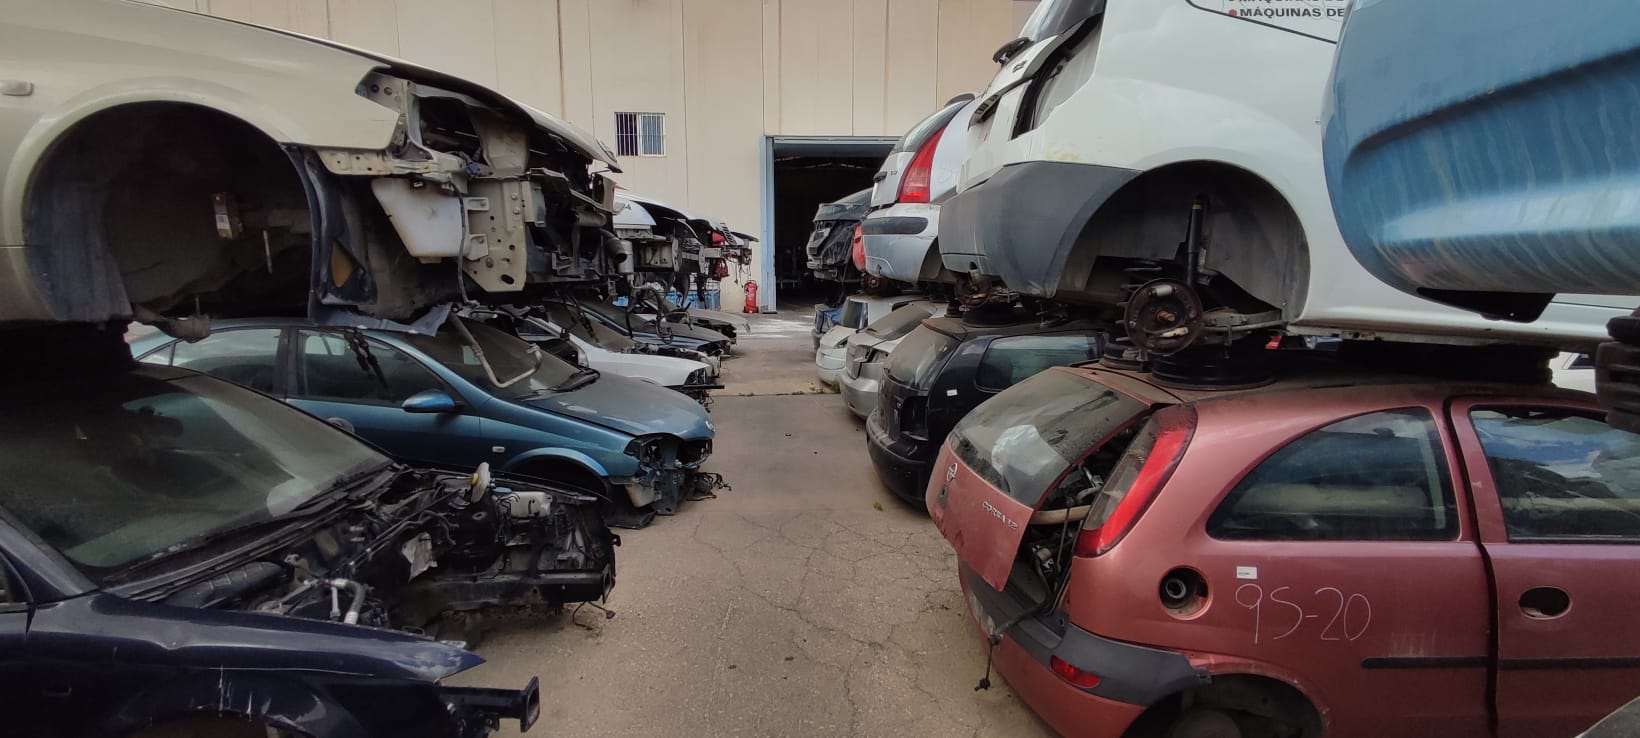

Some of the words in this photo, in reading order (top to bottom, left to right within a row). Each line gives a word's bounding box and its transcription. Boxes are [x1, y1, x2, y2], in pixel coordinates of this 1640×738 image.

[1240, 6, 1322, 18] MÁQUINAS
[1326, 8, 1345, 17] DE
[982, 501, 1006, 523] CORSA
